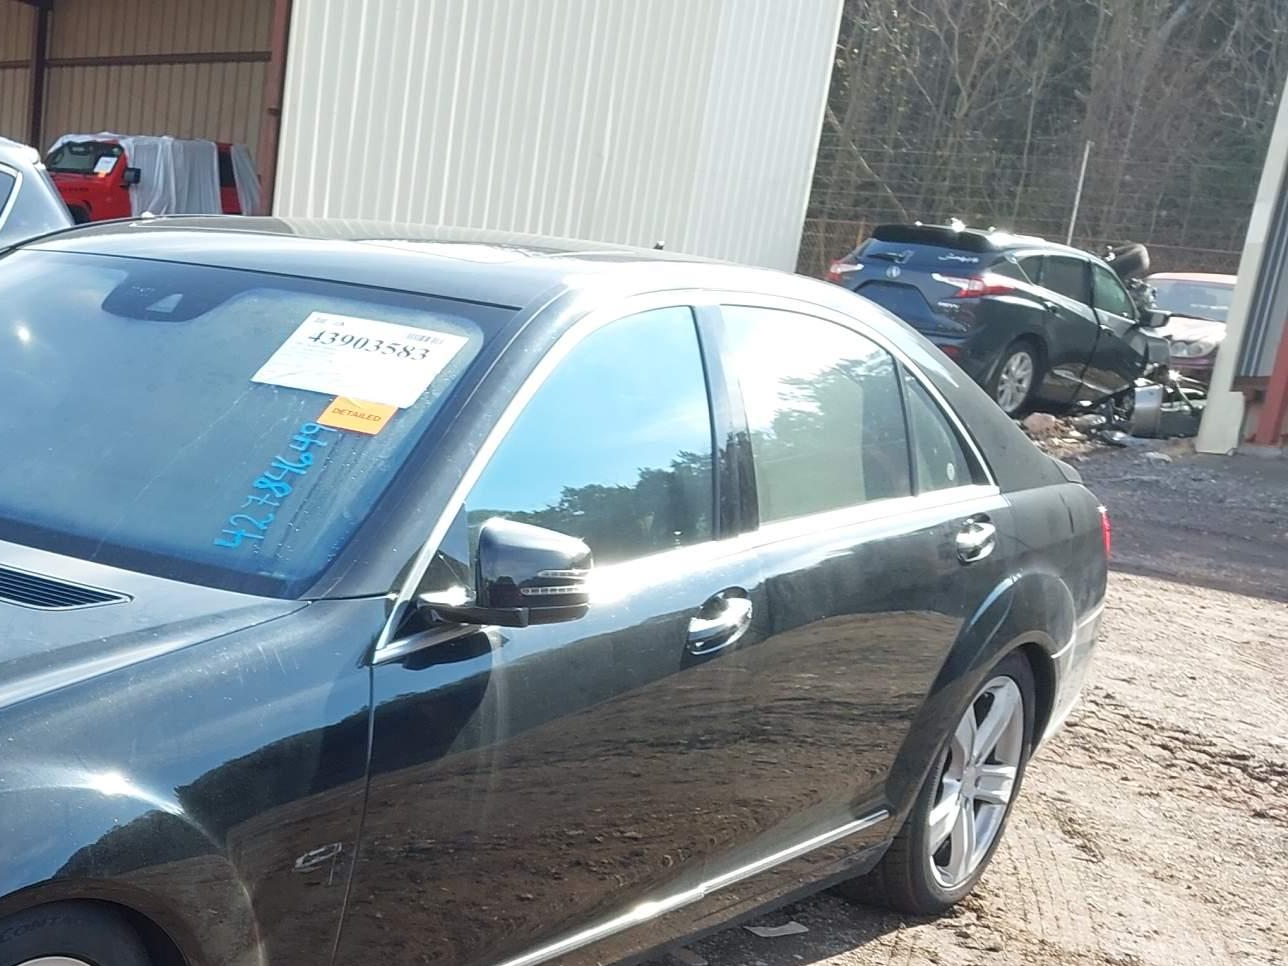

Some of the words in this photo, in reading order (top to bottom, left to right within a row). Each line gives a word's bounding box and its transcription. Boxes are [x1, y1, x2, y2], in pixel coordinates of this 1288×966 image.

[308, 330, 431, 361] 43903583
[332, 406, 382, 423] DETAILED
[214, 421, 339, 548] 42784649
